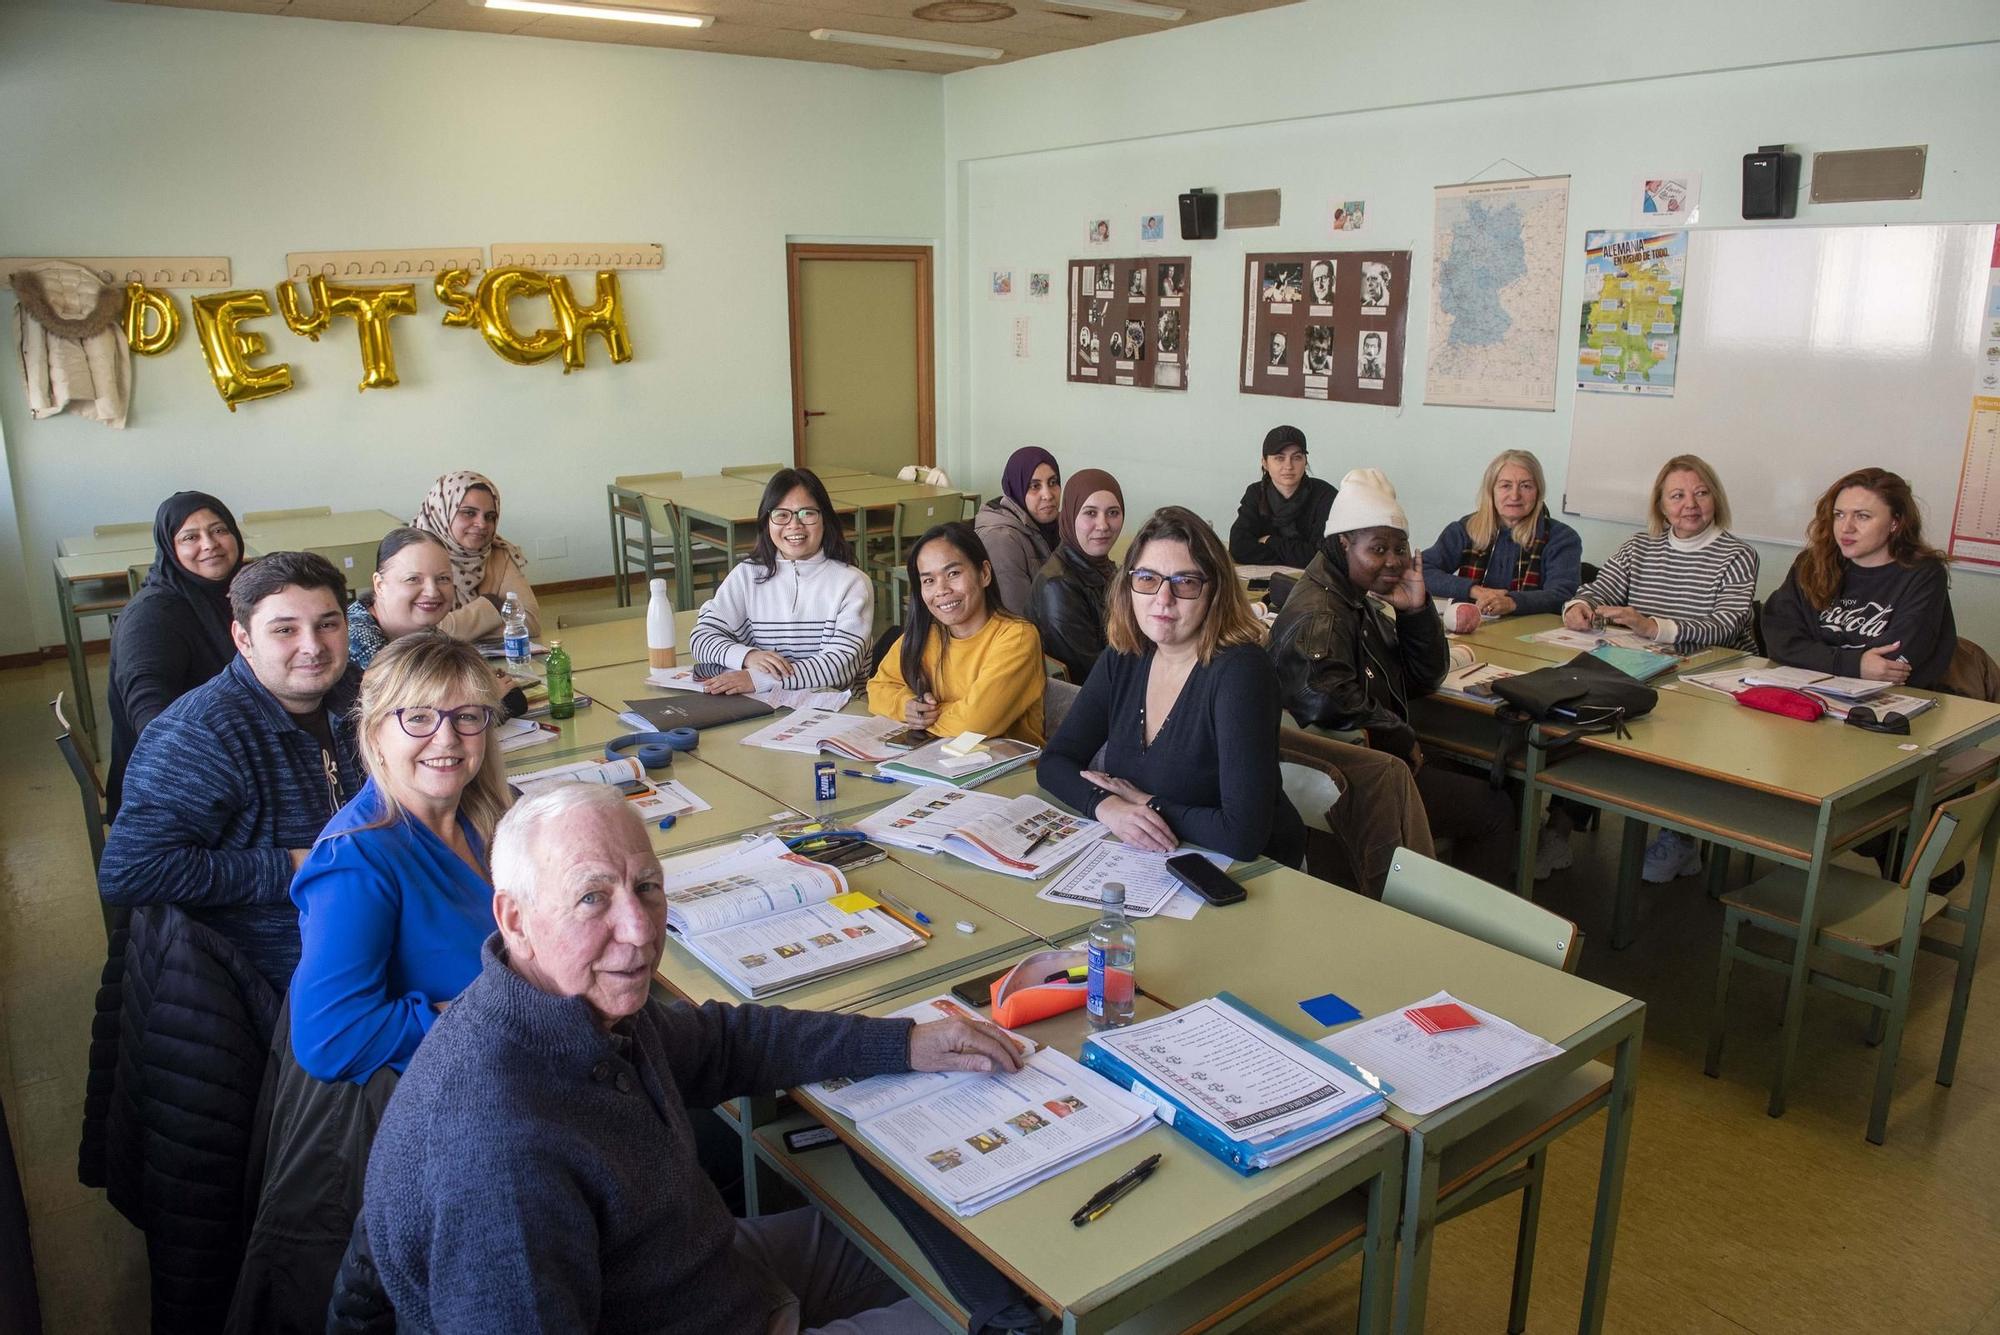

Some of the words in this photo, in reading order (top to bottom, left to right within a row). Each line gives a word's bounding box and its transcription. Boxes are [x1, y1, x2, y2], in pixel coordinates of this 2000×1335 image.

[1603, 239, 1645, 258] ALEMANIA
[1613, 256, 1622, 266] EN
[1643, 250, 1651, 261] DE
[122, 266, 635, 412] DEUTSCH
